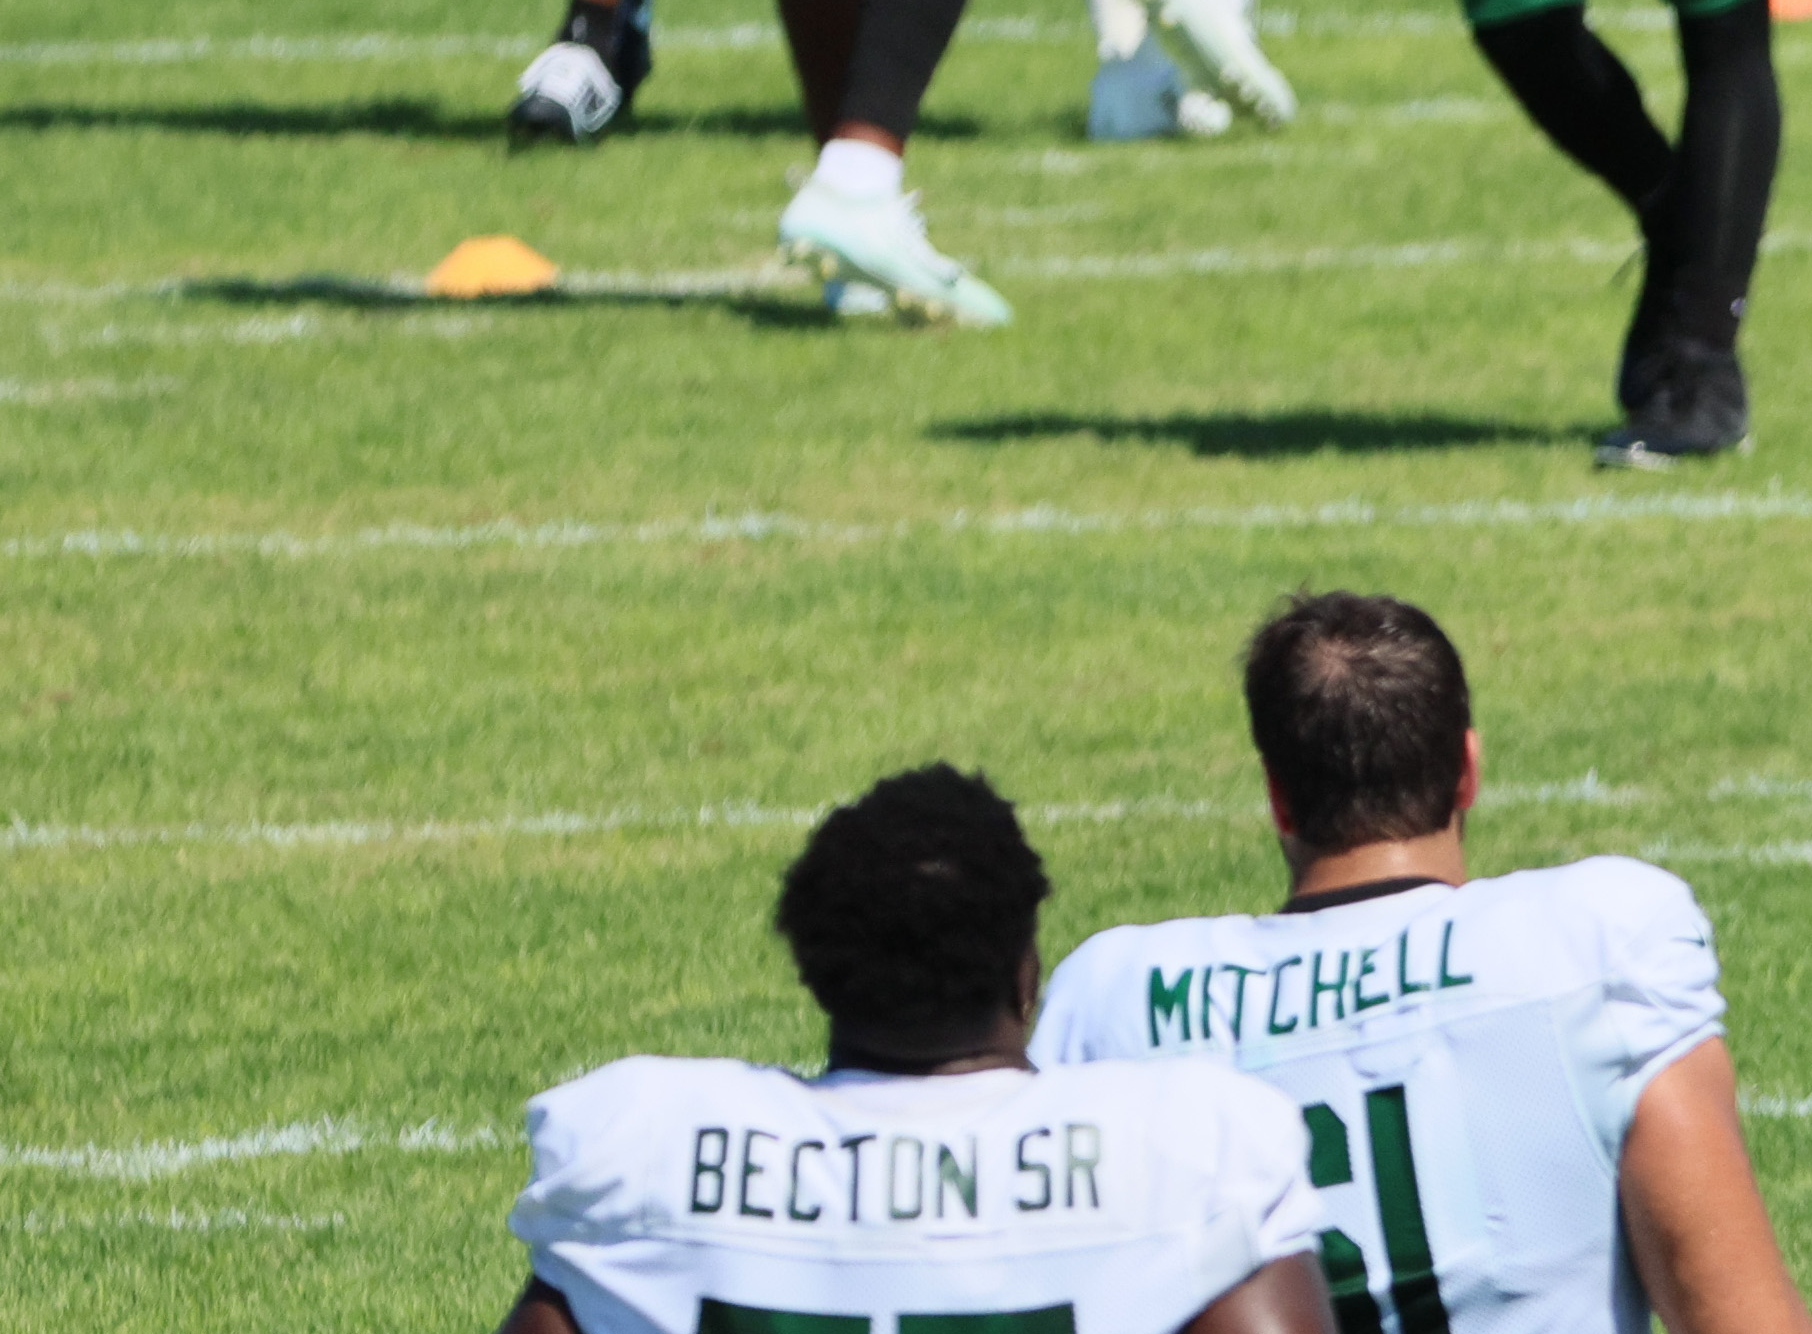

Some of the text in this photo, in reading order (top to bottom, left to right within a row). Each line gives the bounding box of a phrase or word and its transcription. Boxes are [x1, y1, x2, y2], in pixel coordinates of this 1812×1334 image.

[1148, 920, 1475, 1048] MITCHELL
[689, 1123, 1101, 1223] BECTON SR
